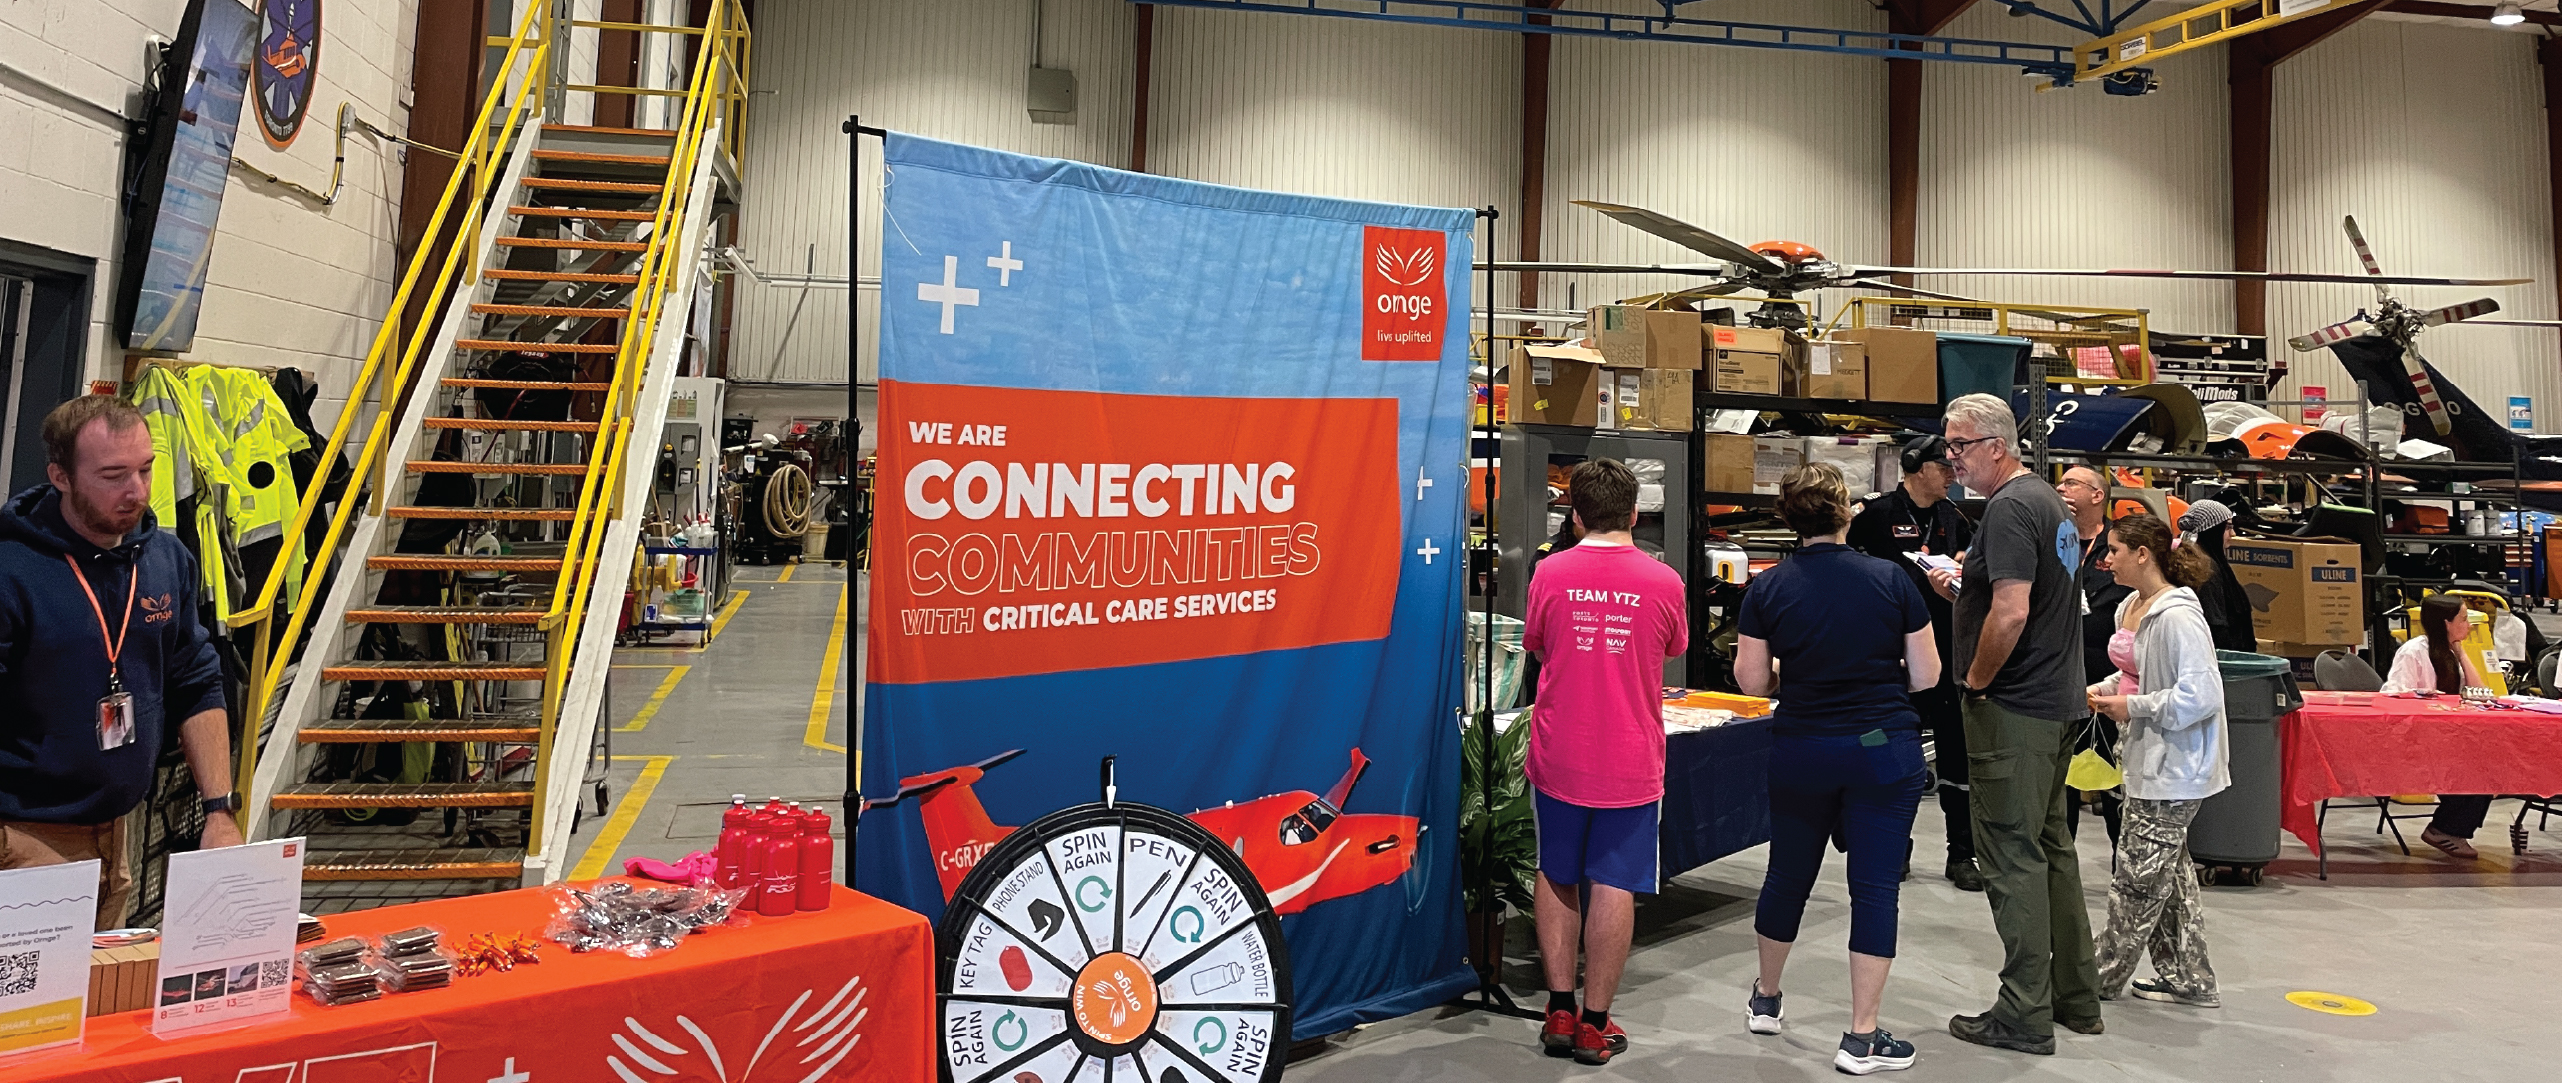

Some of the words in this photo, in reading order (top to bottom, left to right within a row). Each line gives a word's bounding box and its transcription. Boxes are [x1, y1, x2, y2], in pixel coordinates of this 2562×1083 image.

[1394, 330, 1432, 345] uplifted
[908, 421, 953, 444] WE
[957, 424, 1007, 446] ARE
[904, 459, 1296, 520] CONNECTING
[906, 522, 1320, 596] COMMUNITIES
[2224, 549, 2250, 562] LINE
[2253, 552, 2289, 564] SORBENTS
[2321, 569, 2347, 580] ULINE
[901, 607, 975, 635] WITH
[983, 602, 1100, 631] CRITICAL
[1105, 597, 1168, 623] CARE
[1173, 588, 1277, 618] SERVICES
[1566, 589, 1608, 603] TEAM
[1613, 591, 1641, 607] YTZ
[145, 611, 173, 623] ornge
[1605, 614, 1633, 624] porter
[1606, 637, 1627, 648] NAV
[1062, 832, 1107, 857] SPIN
[1129, 838, 1188, 867] PEN
[1064, 850, 1112, 874] AGAIN
[992, 881, 1020, 913] PHONE
[1016, 861, 1044, 887] STAND
[1204, 868, 1243, 913] SPIN
[1190, 881, 1230, 926] AGAIN
[967, 921, 993, 954] TAG
[959, 957, 978, 988] KEY
[1241, 931, 1259, 962] WATER
[1251, 963, 1268, 997] BOTTLE
[226, 999, 237, 1008] 13
[1076, 984, 1086, 1011] WIN
[1114, 969, 1141, 1012] ornge
[160, 1010, 168, 1019] 8
[194, 1004, 205, 1014] 12
[1079, 1012, 1090, 1027] TO
[951, 1015, 971, 1067] SPIN
[970, 1010, 988, 1064] AGAIN
[1088, 1025, 1112, 1041] SPIN
[1226, 1017, 1250, 1072] AGAIN
[1241, 1025, 1267, 1076] SPIN
